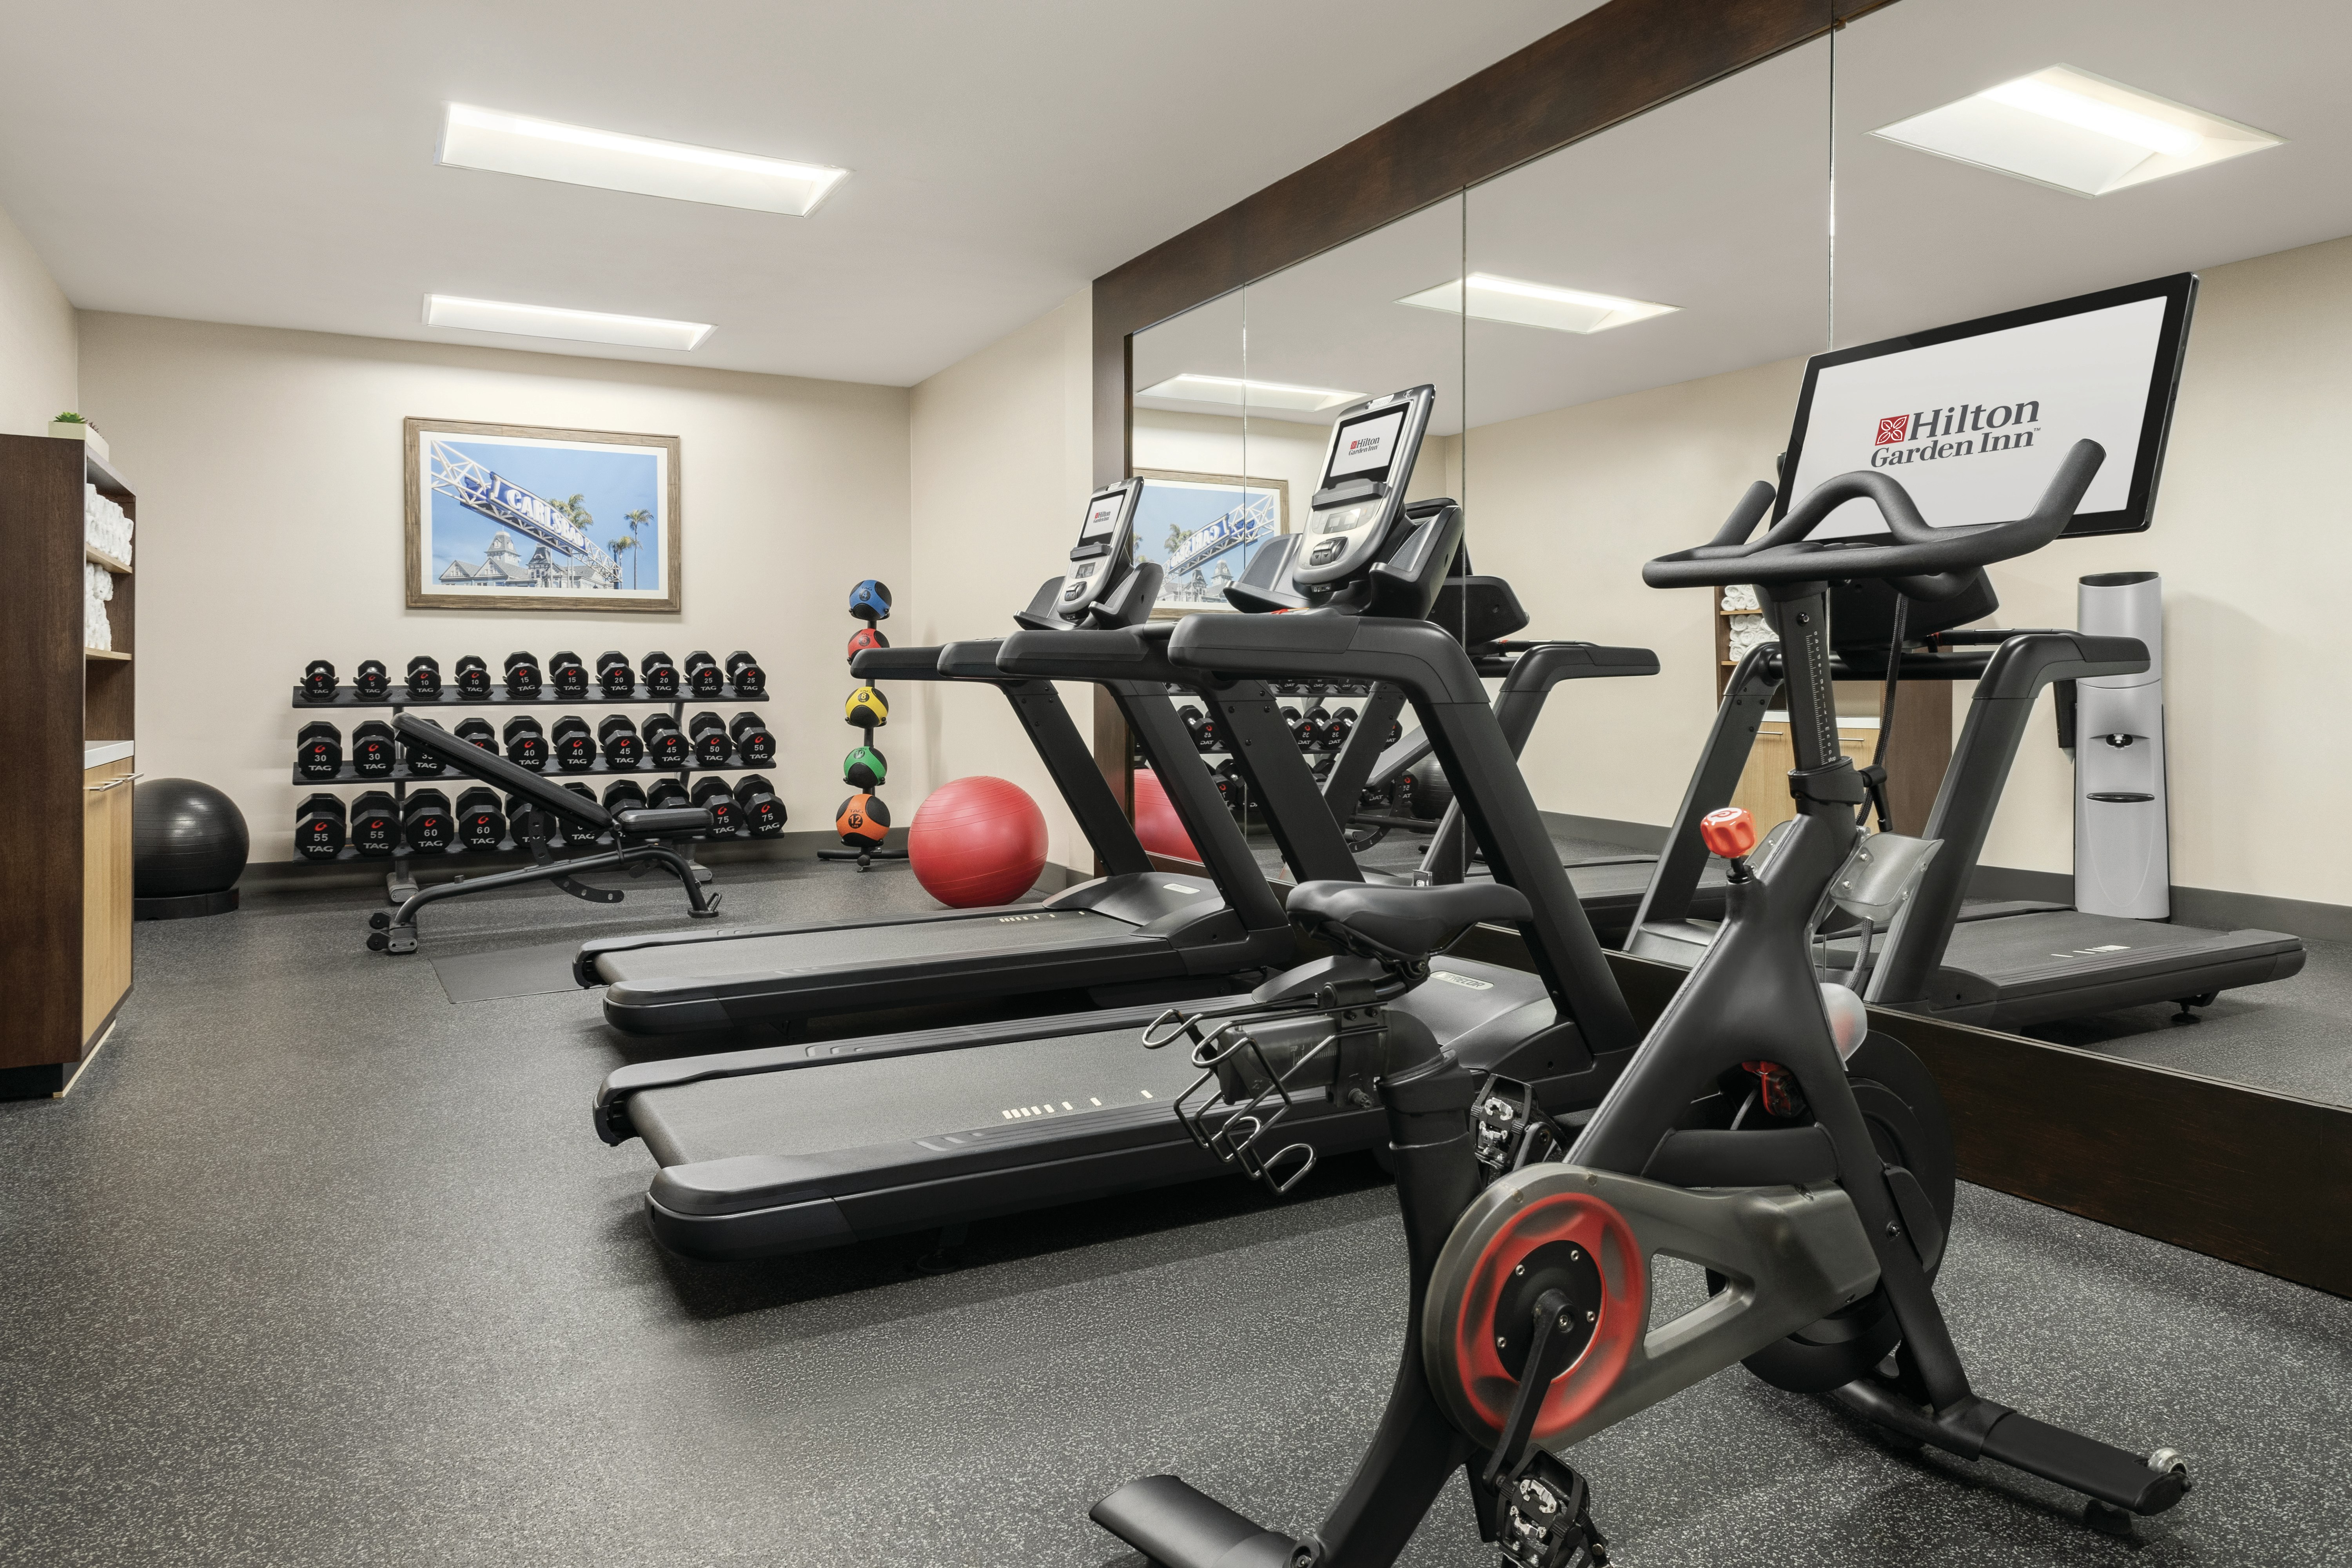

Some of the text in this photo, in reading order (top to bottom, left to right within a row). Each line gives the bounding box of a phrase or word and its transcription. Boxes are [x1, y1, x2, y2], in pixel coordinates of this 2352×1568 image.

[1908, 401, 2039, 441] Hilton
[1356, 437, 1380, 448] Hilton
[1871, 440, 1973, 467] Garden
[506, 490, 584, 547] CARLSBAD
[850, 815, 861, 824] 12
[759, 822, 780, 831] TAG
[1447, 974, 1485, 987] PRECOR
